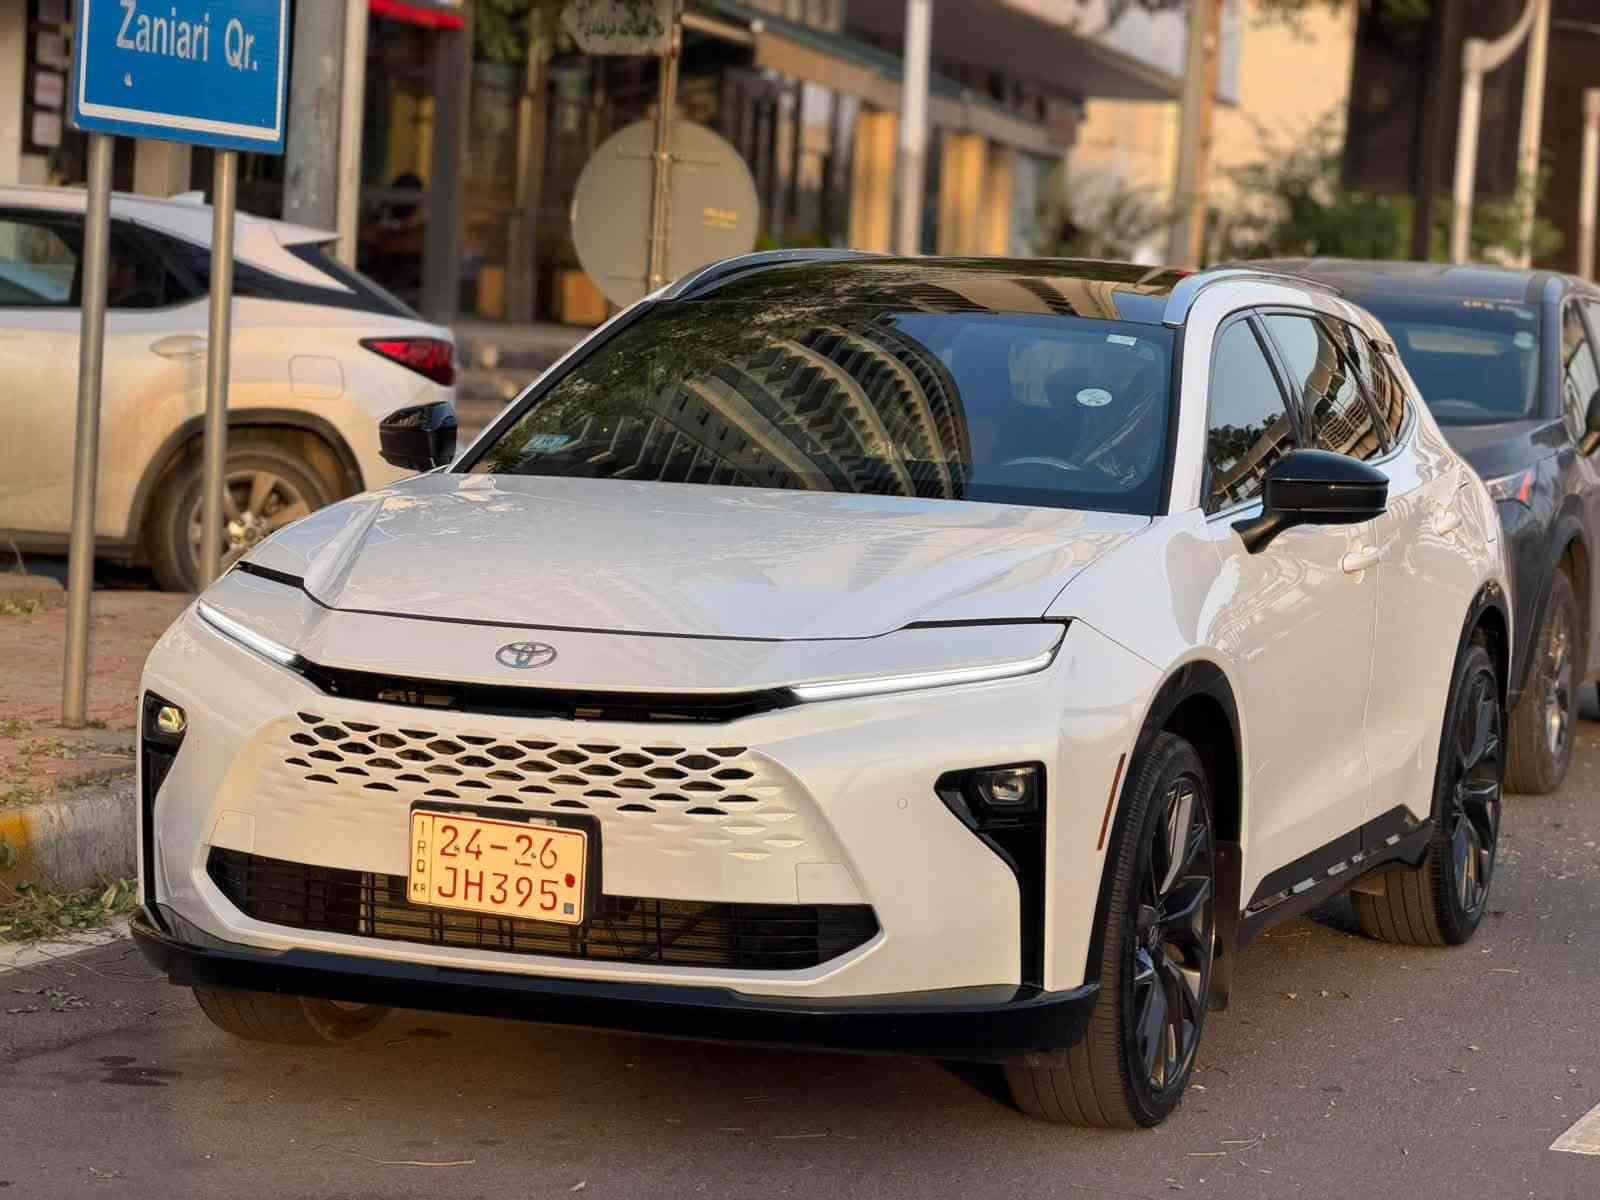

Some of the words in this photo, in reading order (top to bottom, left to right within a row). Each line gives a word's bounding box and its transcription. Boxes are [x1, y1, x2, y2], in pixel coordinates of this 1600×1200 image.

[116, 0, 210, 62] Zaniari
[225, 18, 258, 71] Qr.
[440, 825, 558, 869] 24-26
[438, 867, 559, 911] JH395
